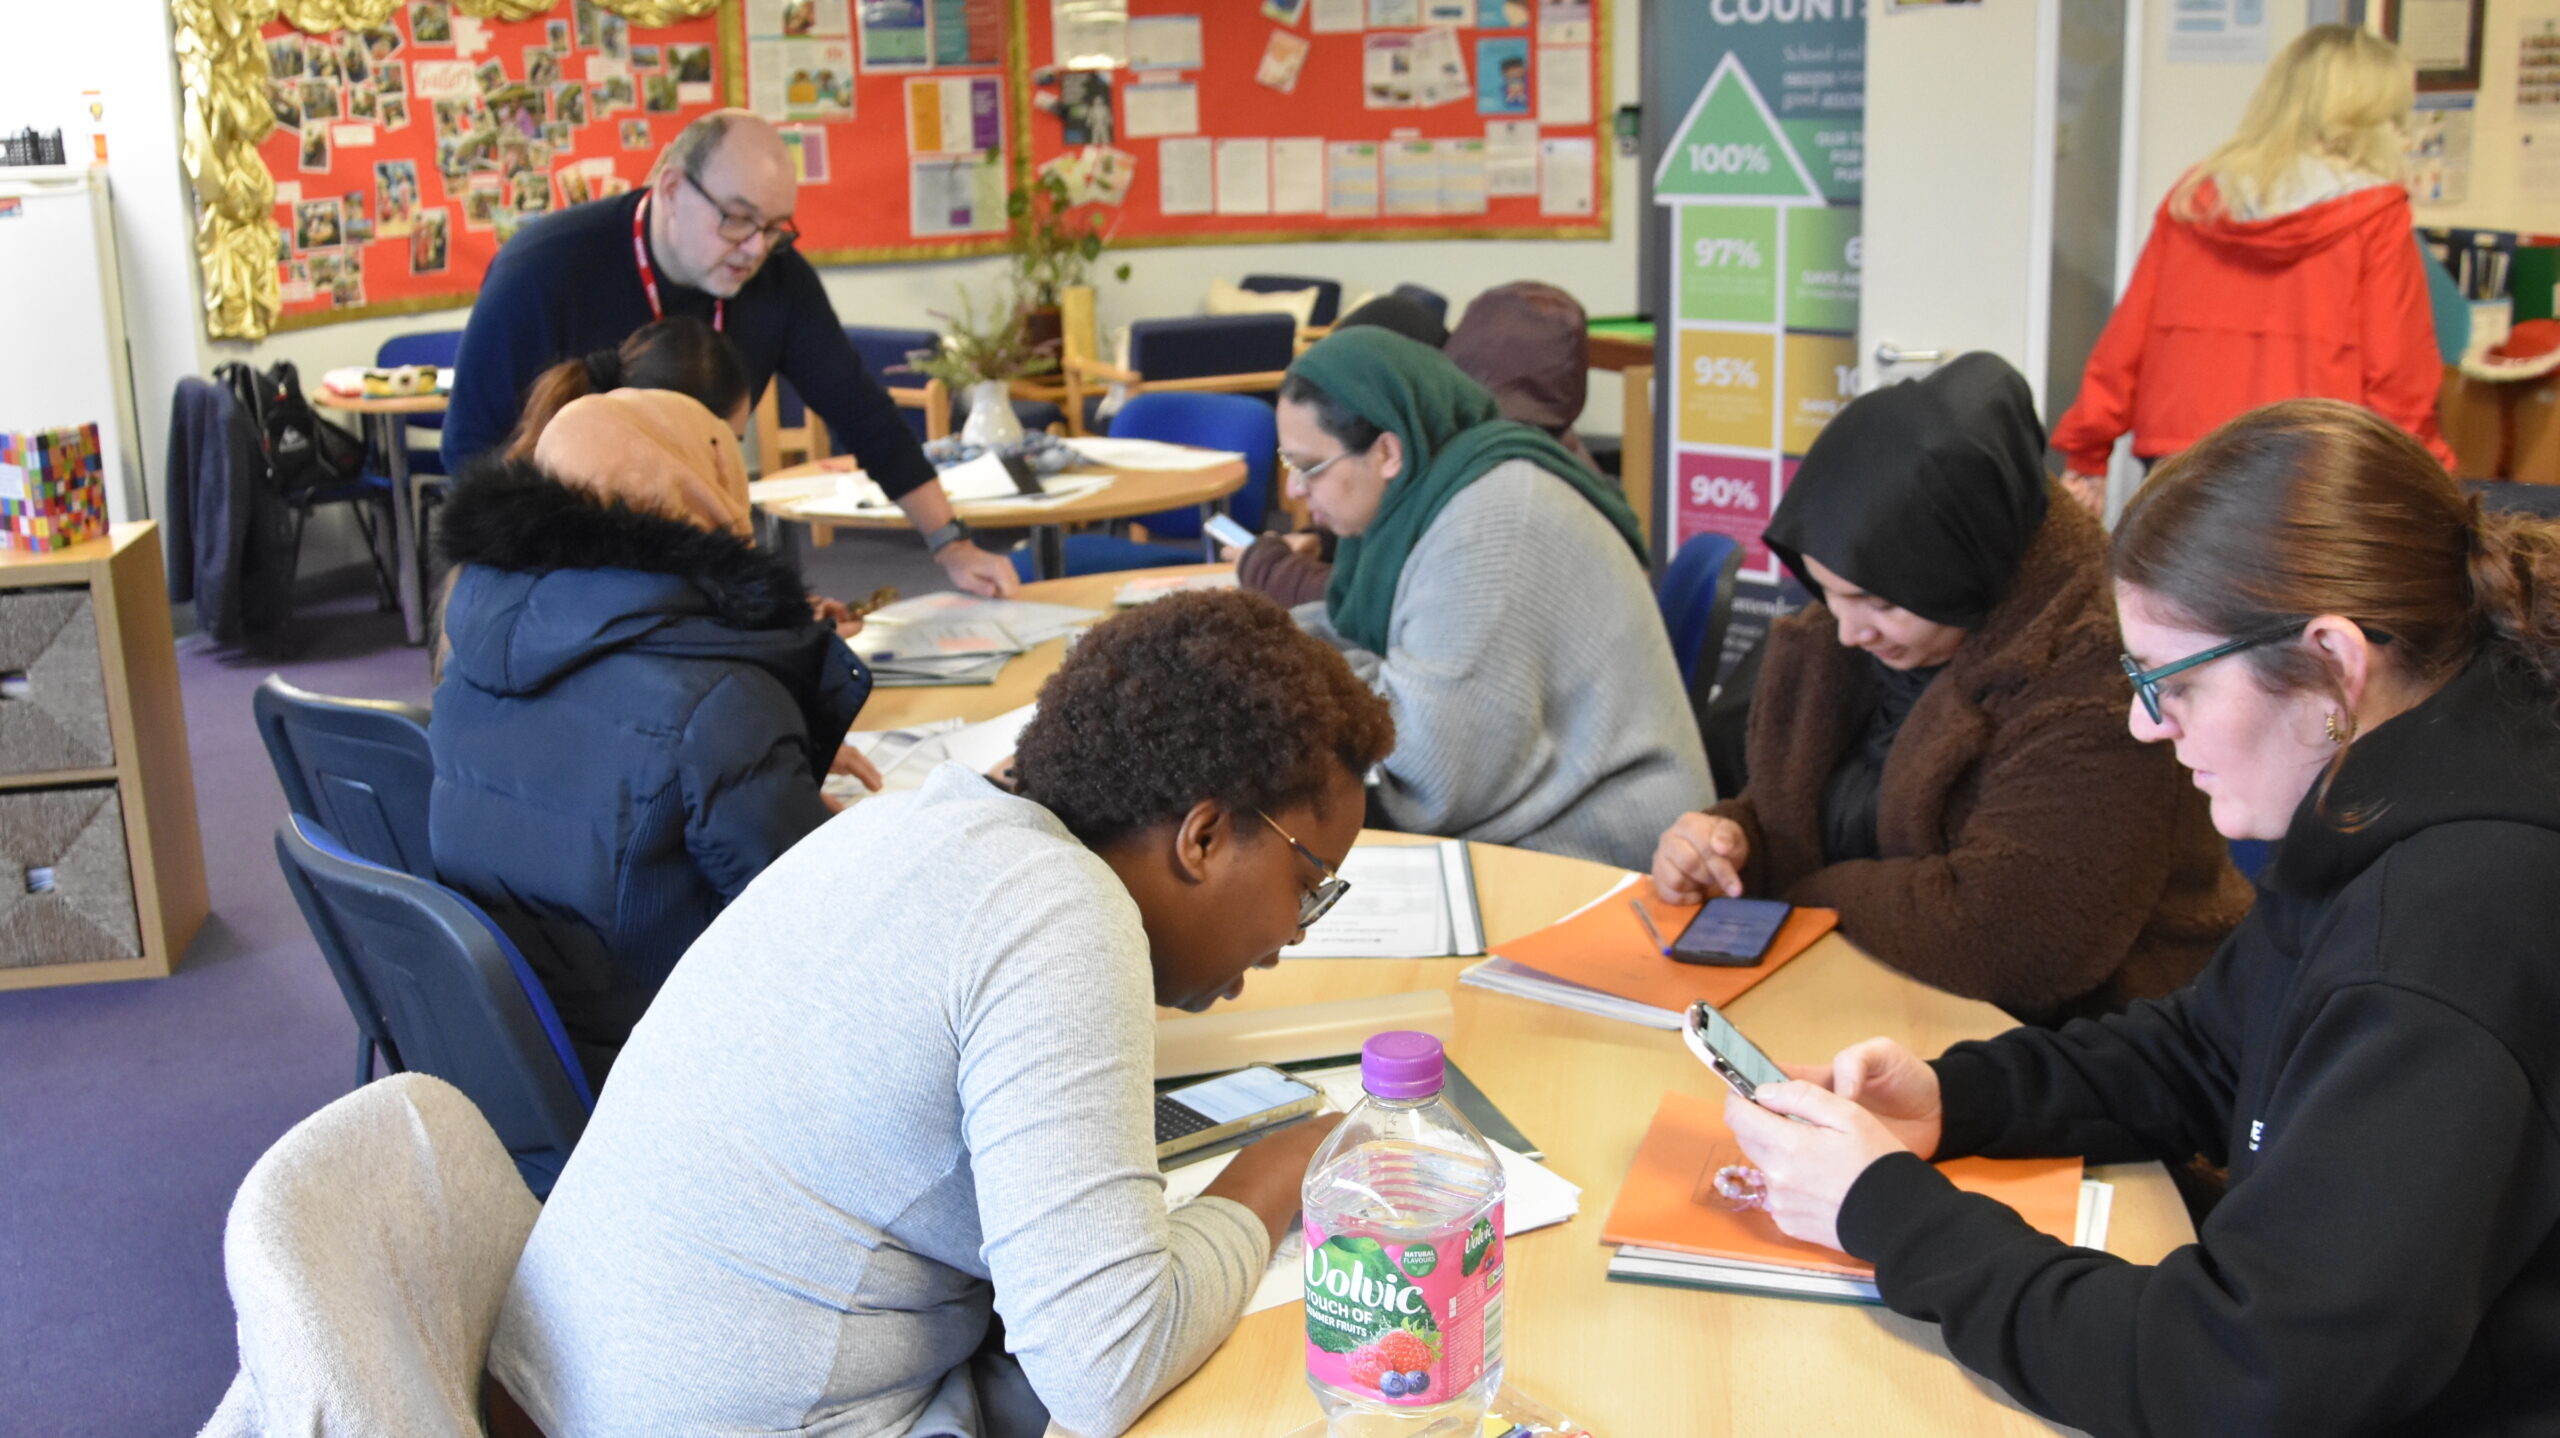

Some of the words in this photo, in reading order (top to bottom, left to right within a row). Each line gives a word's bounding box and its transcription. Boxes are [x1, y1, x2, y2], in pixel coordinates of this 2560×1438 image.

[1688, 143, 1771, 173] 100%
[1695, 237, 1762, 269] 97%
[1693, 355, 1761, 389] 95%
[1690, 474, 1760, 510] 90%
[1404, 1249, 1434, 1258] NATURAL
[1463, 1223, 1494, 1254] Volvic
[1403, 1257, 1436, 1265] FLAVOURS
[1306, 1240, 1424, 1315] Volvic
[1306, 1286, 1349, 1319] TOUCH
[1352, 1307, 1373, 1325] OF
[1336, 1319, 1367, 1337] FRUITS
